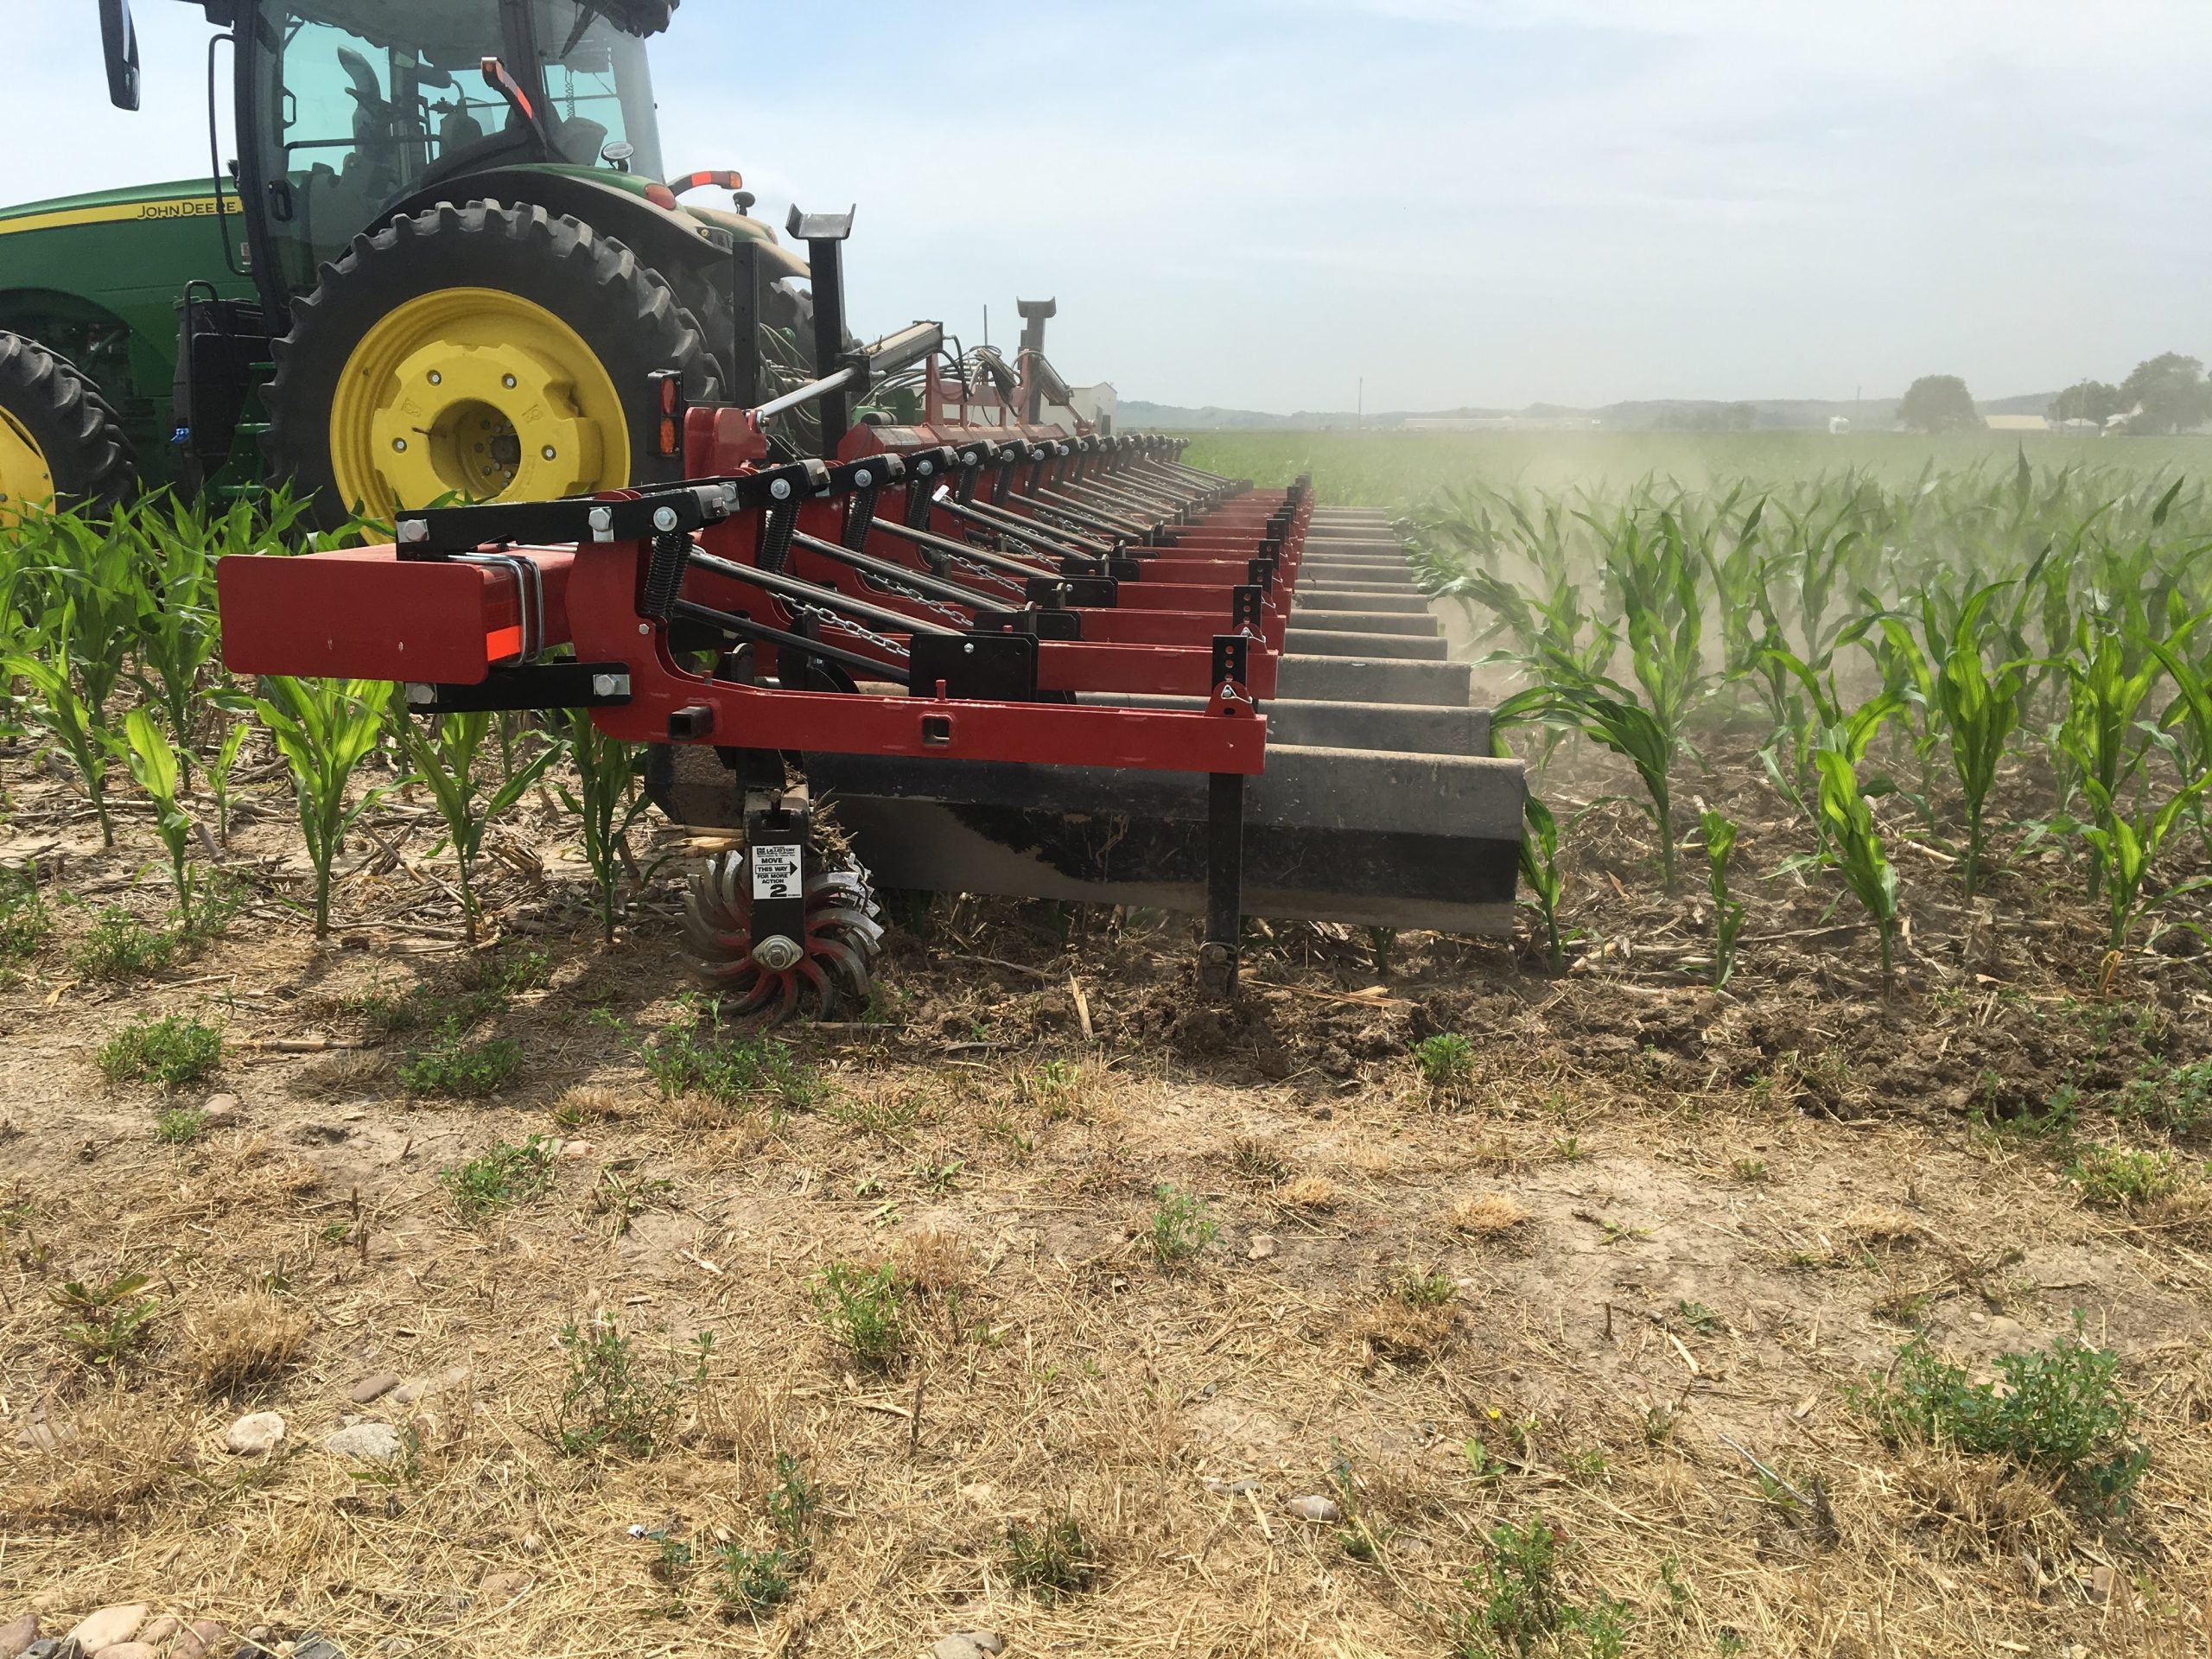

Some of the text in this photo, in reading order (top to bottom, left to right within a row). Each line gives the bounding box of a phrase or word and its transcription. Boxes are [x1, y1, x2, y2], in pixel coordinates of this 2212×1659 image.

[137, 202, 235, 218] JOHN DEEE
[770, 884, 787, 897] 2
